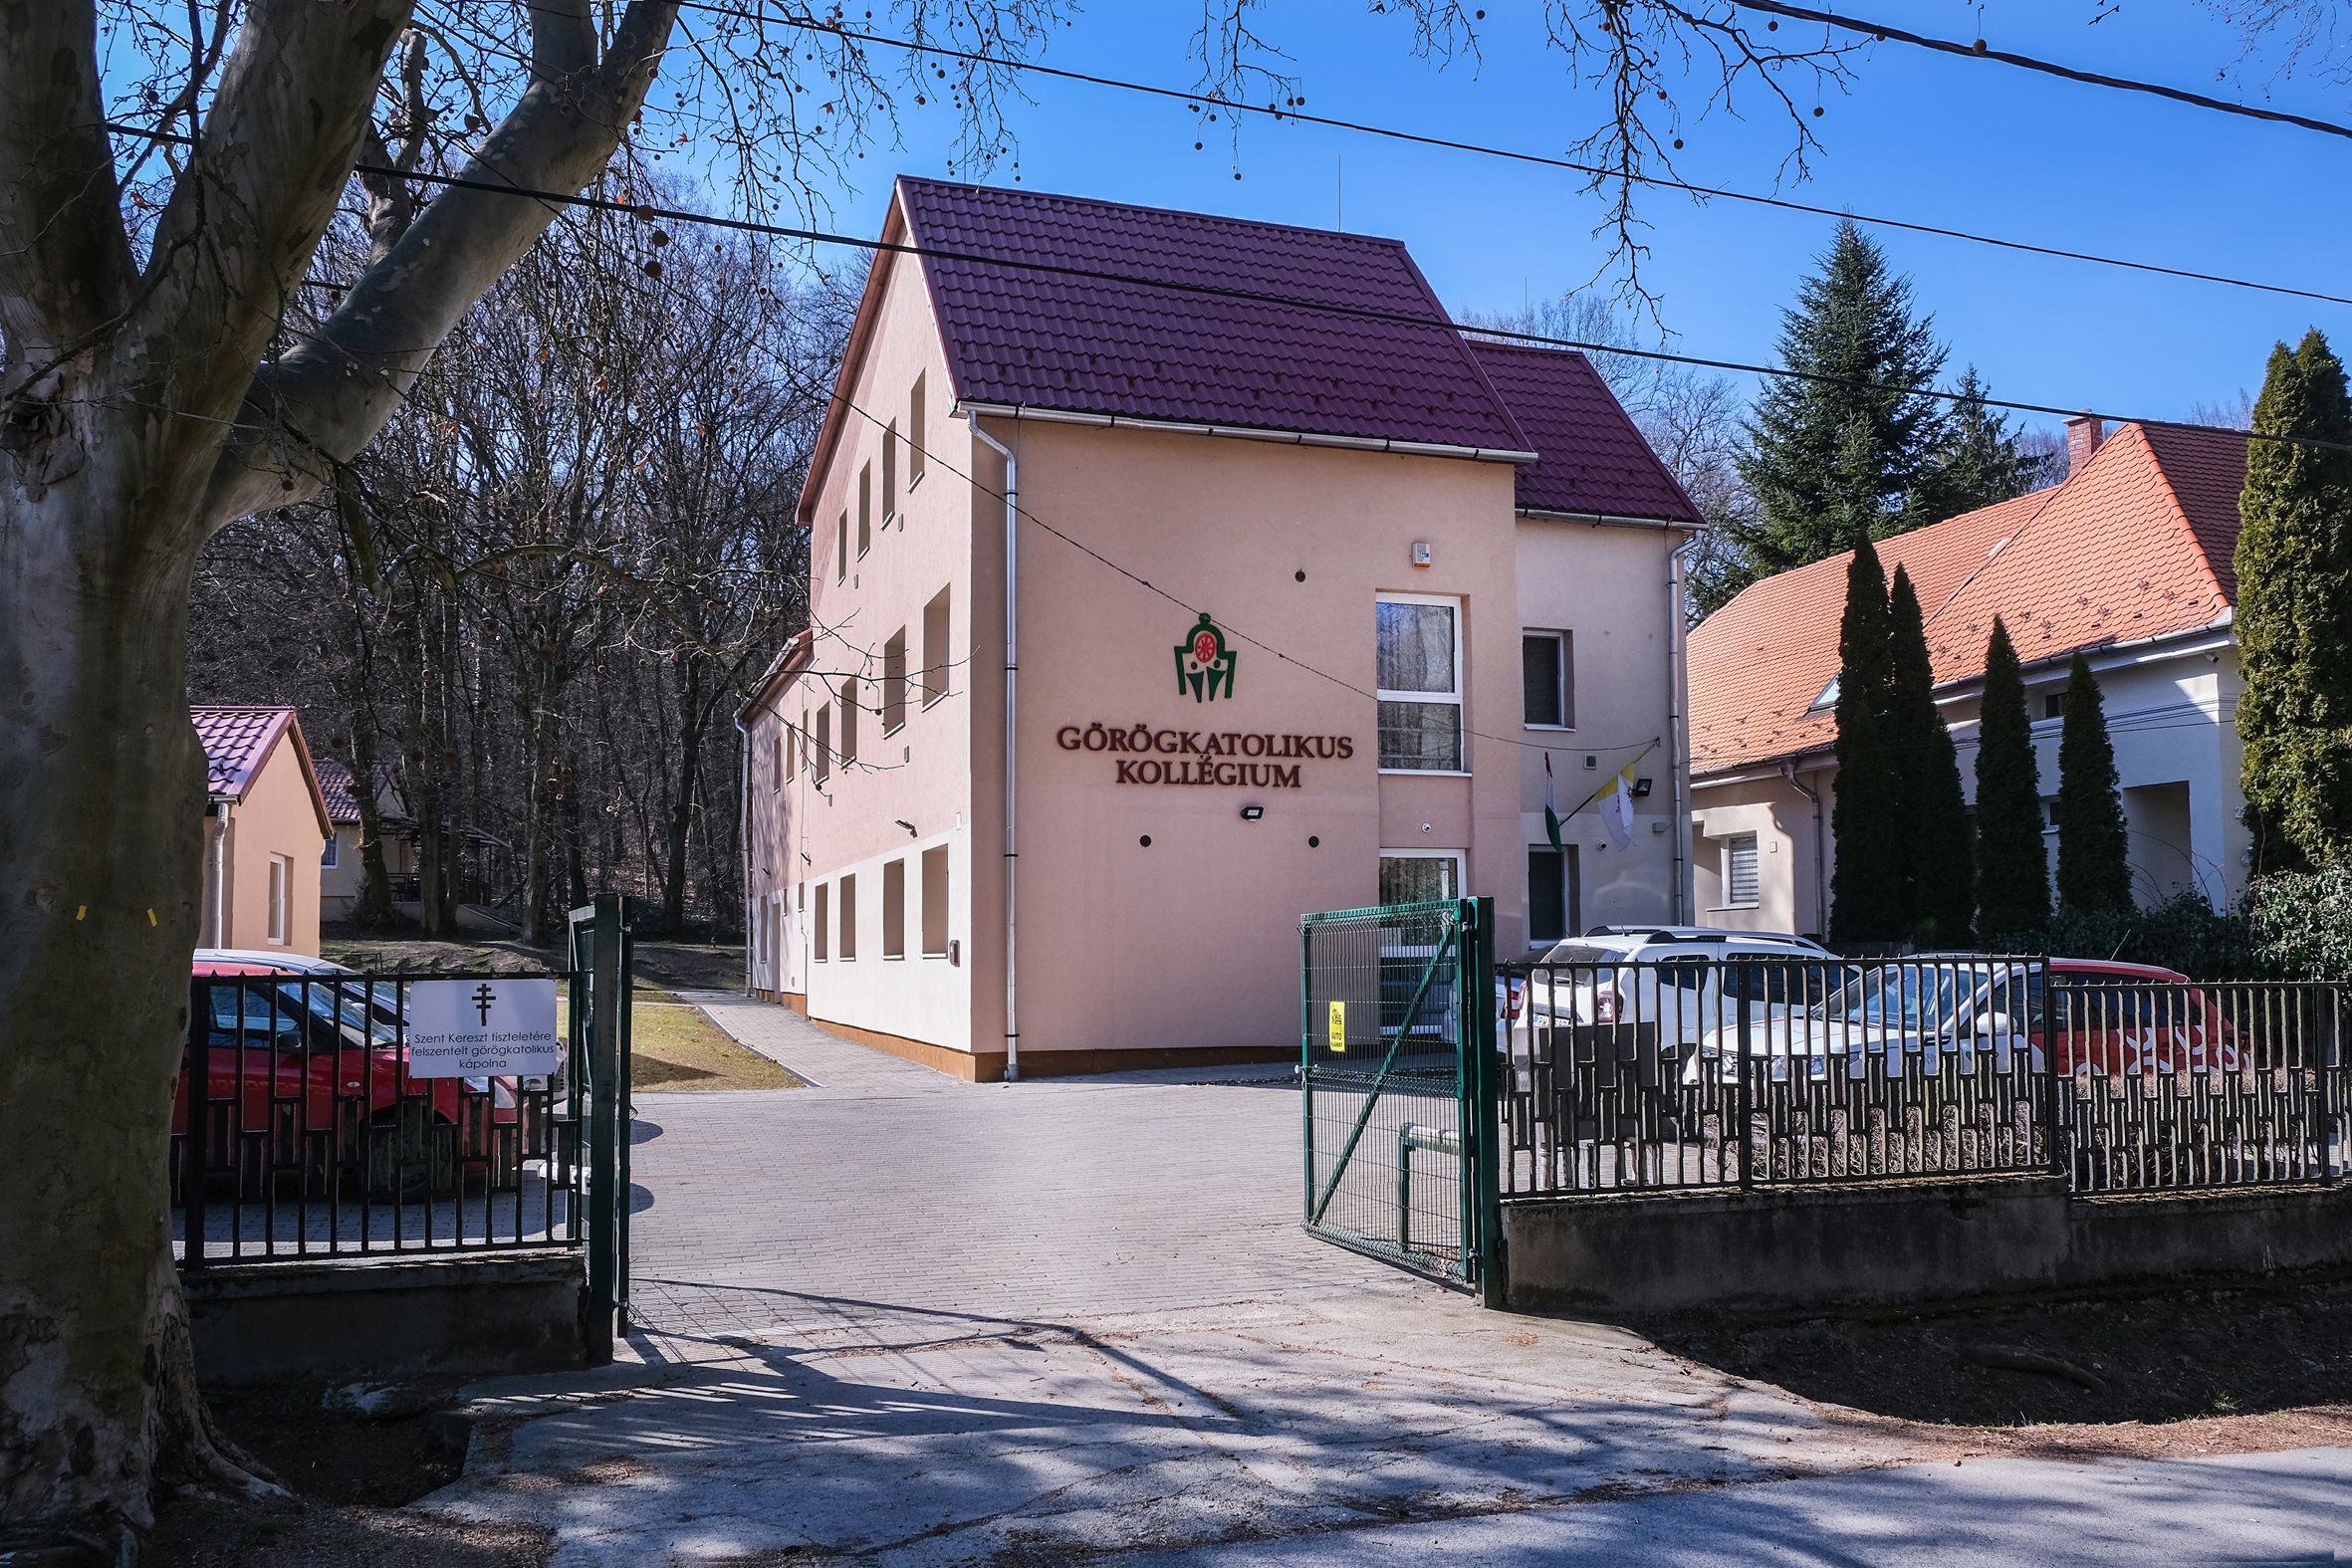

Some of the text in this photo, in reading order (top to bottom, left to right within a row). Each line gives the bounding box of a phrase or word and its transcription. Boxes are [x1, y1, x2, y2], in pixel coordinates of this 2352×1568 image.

[1057, 722, 1354, 760] GÖRÖGKATOLIKUS
[1115, 755, 1302, 788] KOLLÉGIUM
[414, 1030, 552, 1044] Szent Kereszt tiszteletére
[411, 1043, 555, 1057] felszentelt görögkatolikus
[459, 1058, 507, 1071] kápolna
